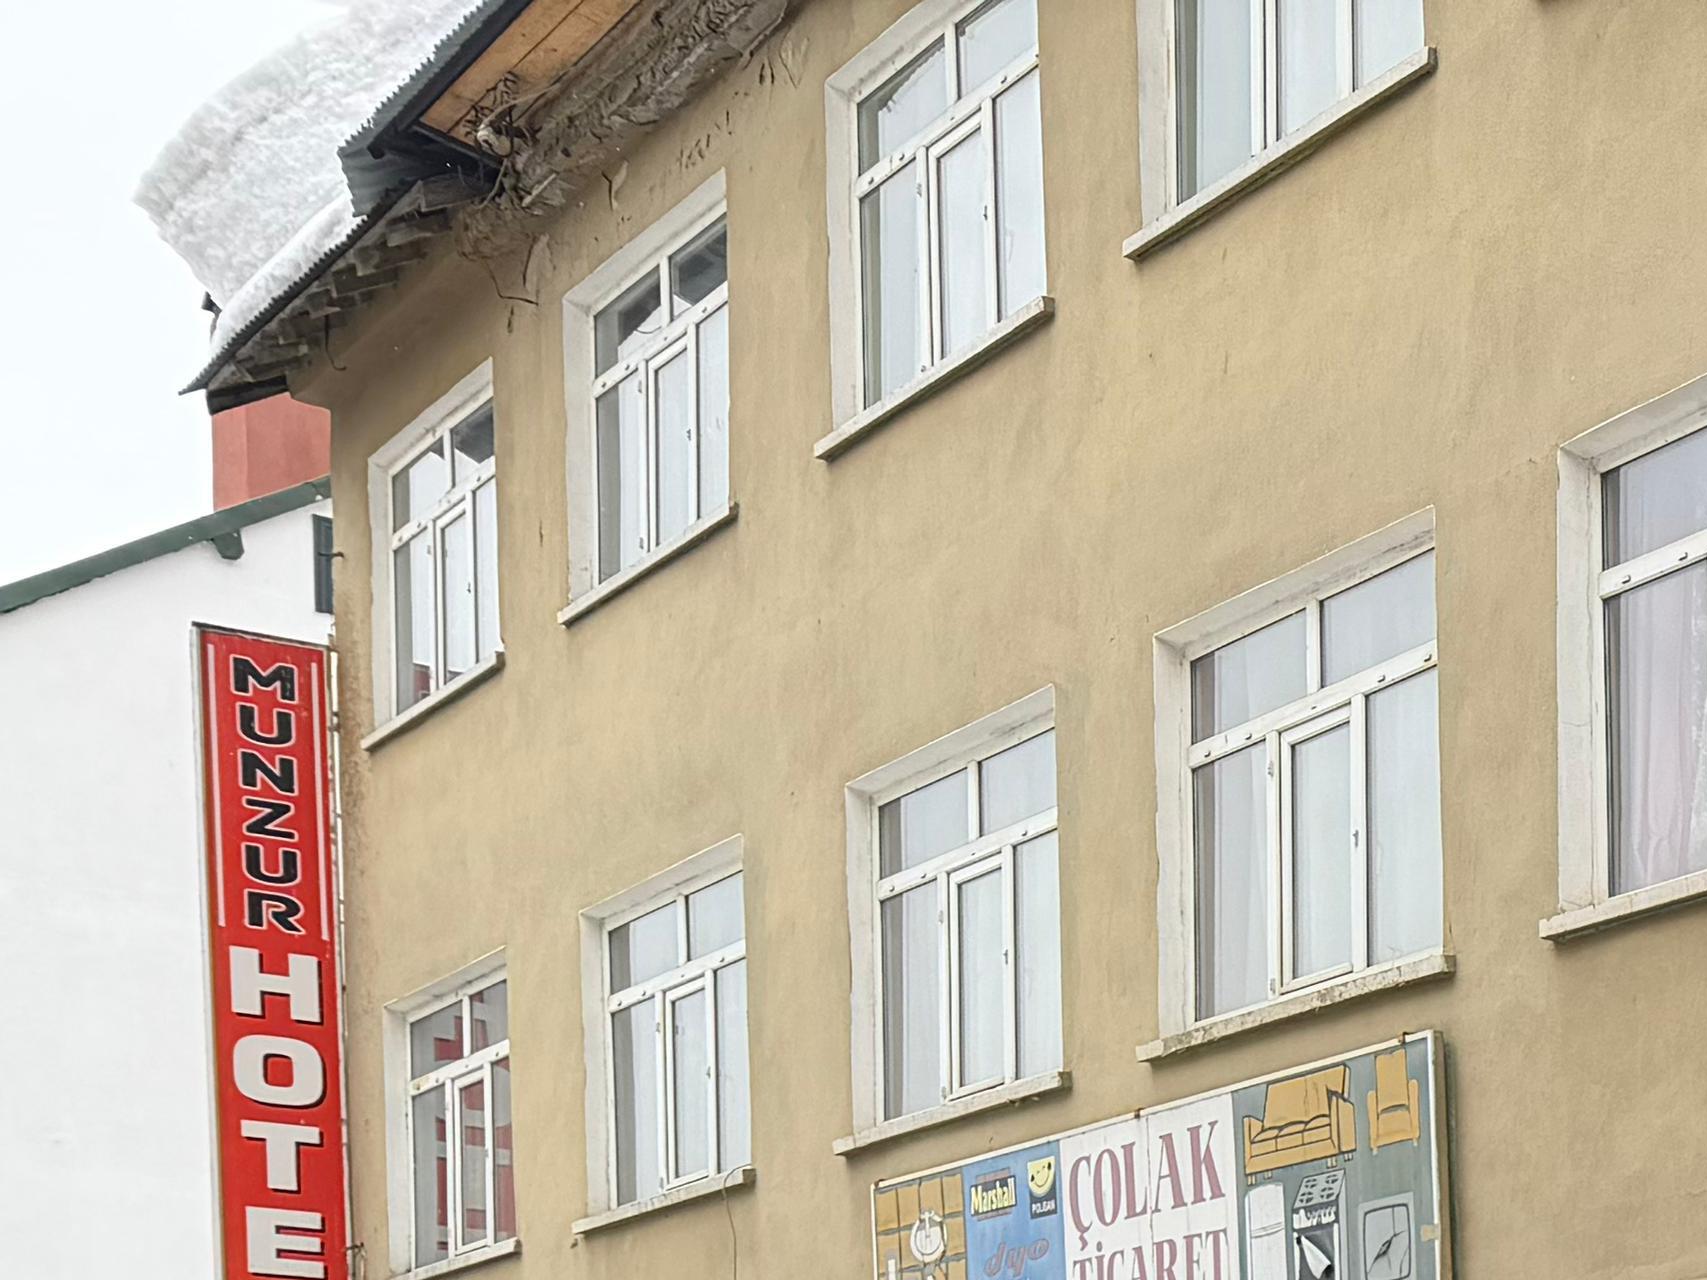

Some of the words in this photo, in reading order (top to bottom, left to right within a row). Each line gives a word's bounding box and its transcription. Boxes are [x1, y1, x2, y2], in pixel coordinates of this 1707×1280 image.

[231, 655, 305, 935] MUNZUR
[971, 1177, 1016, 1215] Marshall
[1069, 1119, 1227, 1251] ÇOLAK
[984, 1238, 1050, 1279] dyo
